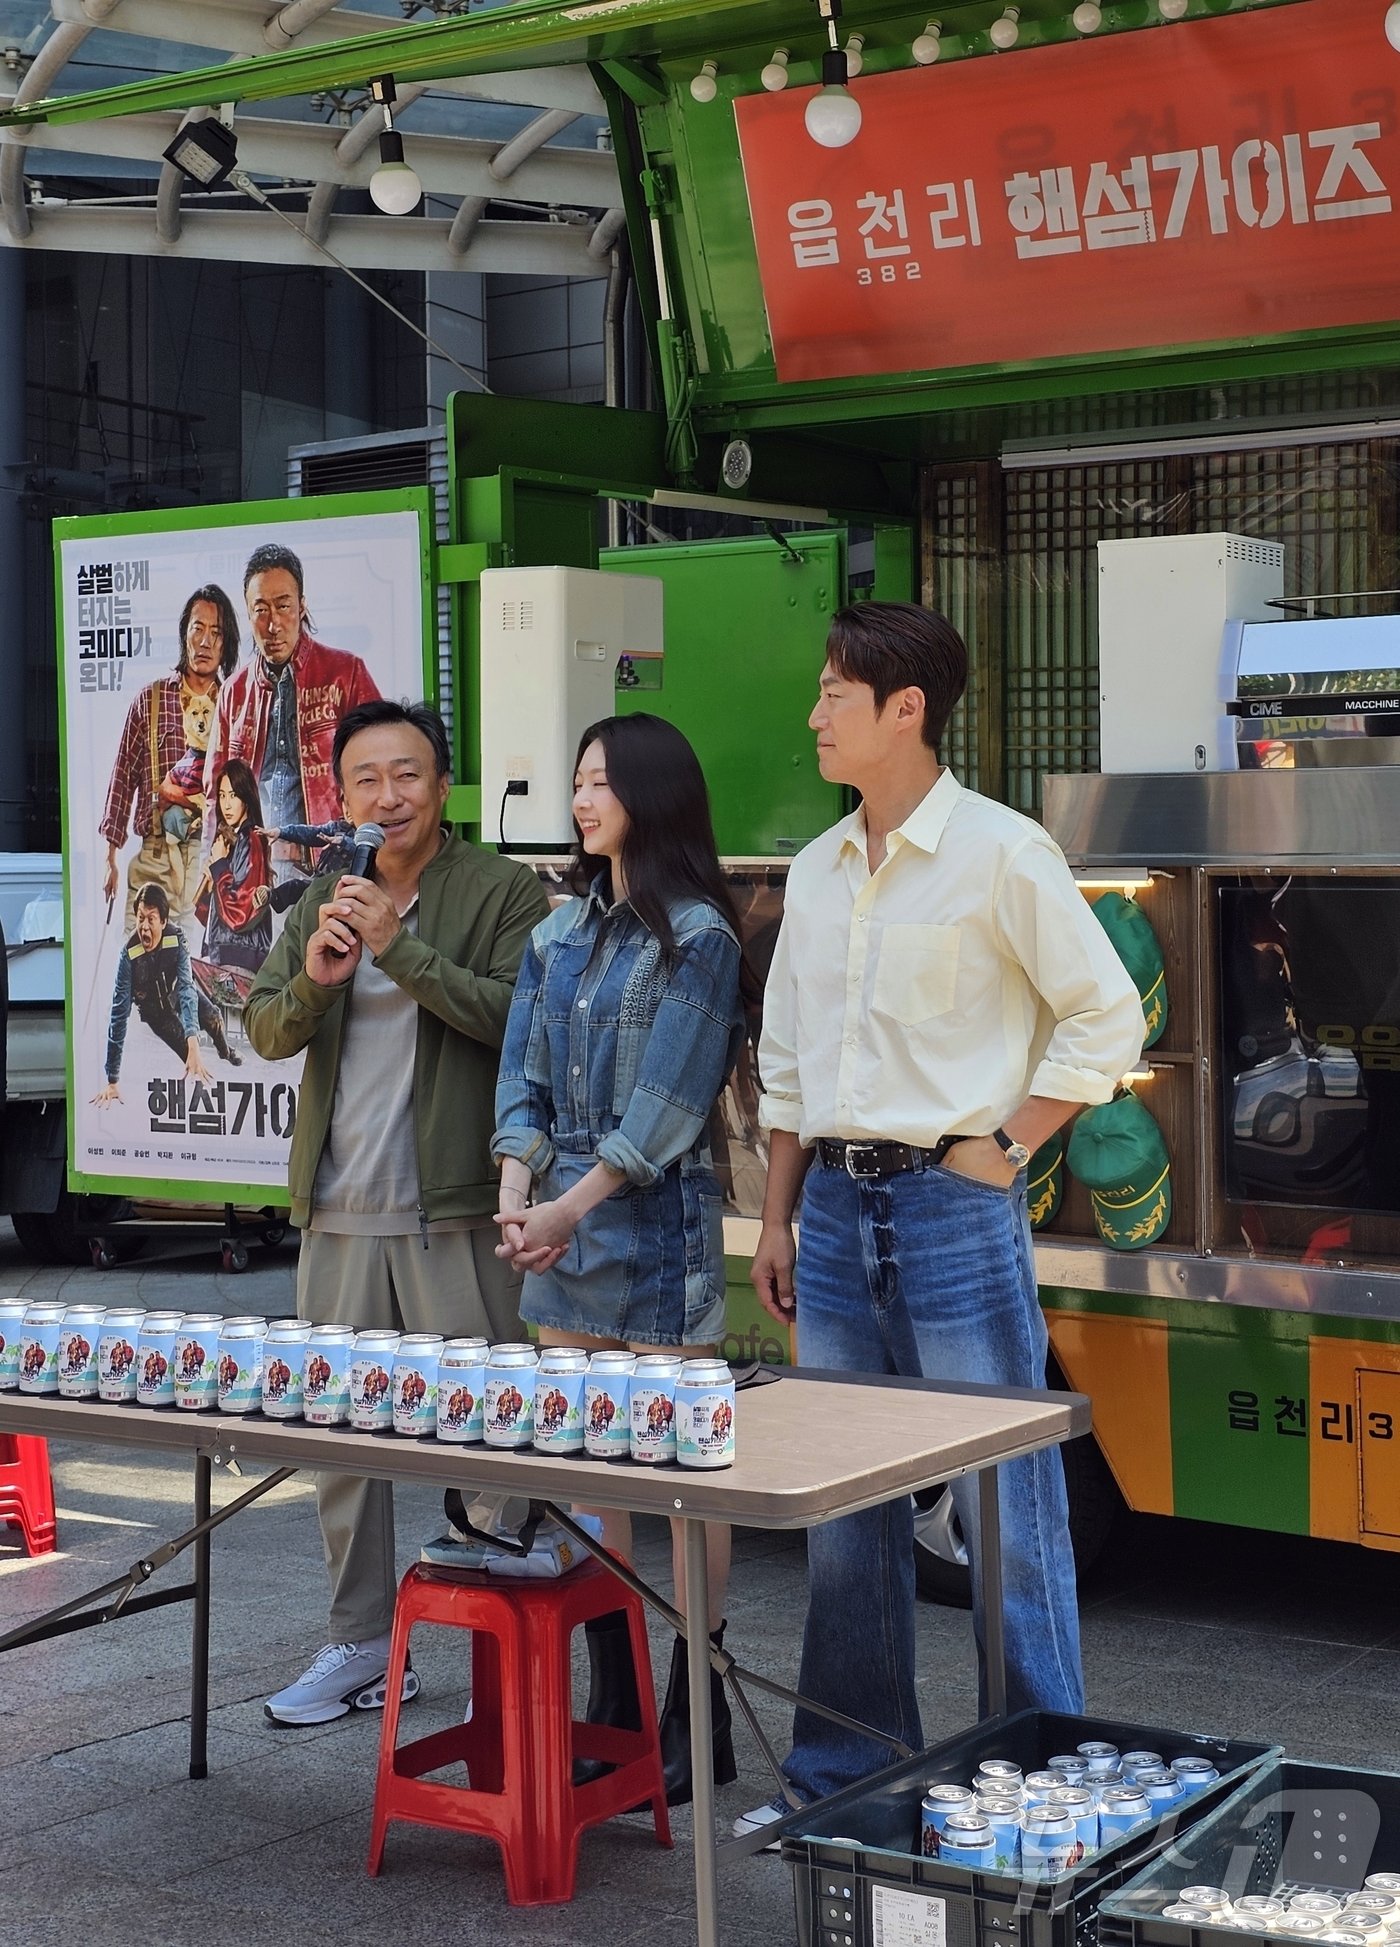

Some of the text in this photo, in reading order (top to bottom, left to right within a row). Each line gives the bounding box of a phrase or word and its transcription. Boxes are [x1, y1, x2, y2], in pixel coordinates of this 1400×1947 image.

[1003, 121, 1392, 260] 핸섬가이즈
[856, 262, 921, 285] 382
[77, 560, 150, 596] 살벌하게
[77, 595, 132, 628] 터지는
[79, 626, 152, 660] 코미디가
[79, 660, 124, 693] 온다!
[1249, 699, 1400, 716] CIME MACCHINE
